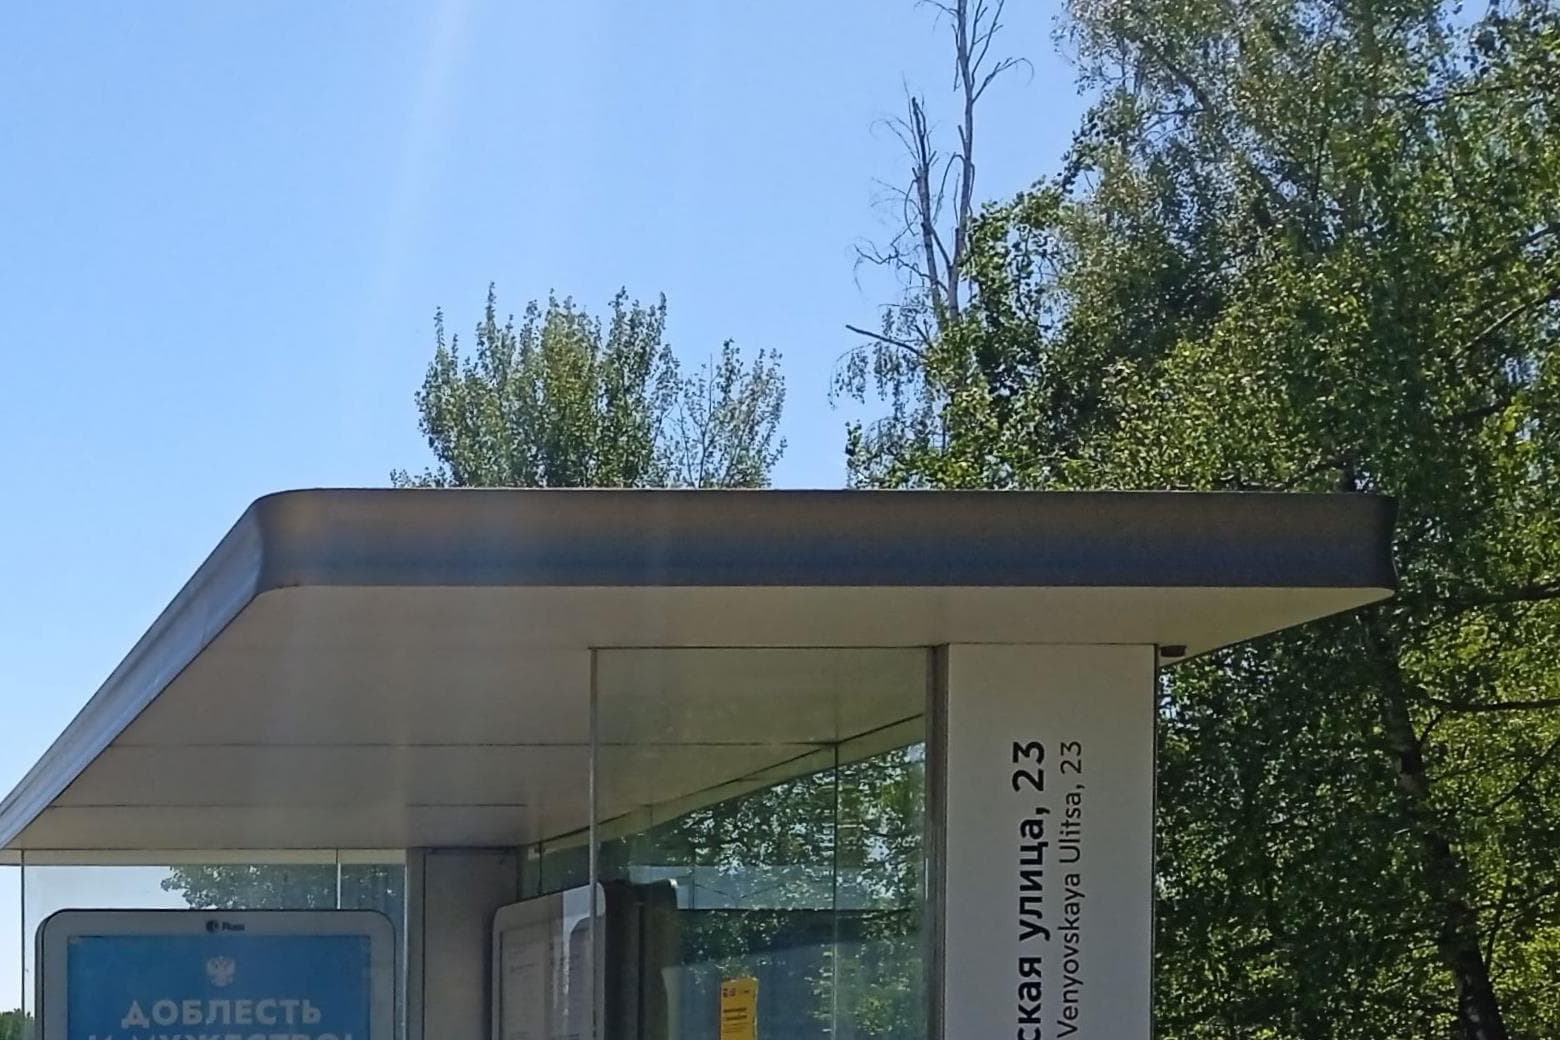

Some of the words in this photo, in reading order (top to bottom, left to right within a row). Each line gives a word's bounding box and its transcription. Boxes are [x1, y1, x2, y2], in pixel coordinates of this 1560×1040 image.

[1012, 740, 1045, 793] 23
[1060, 740, 1082, 775] 23
[1058, 783, 1085, 864] Ulitsa,
[1018, 806, 1051, 942] улица,
[1057, 872, 1085, 1039] Venyovskaya
[121, 998, 322, 1029] ДОБЛЕСТЬ
